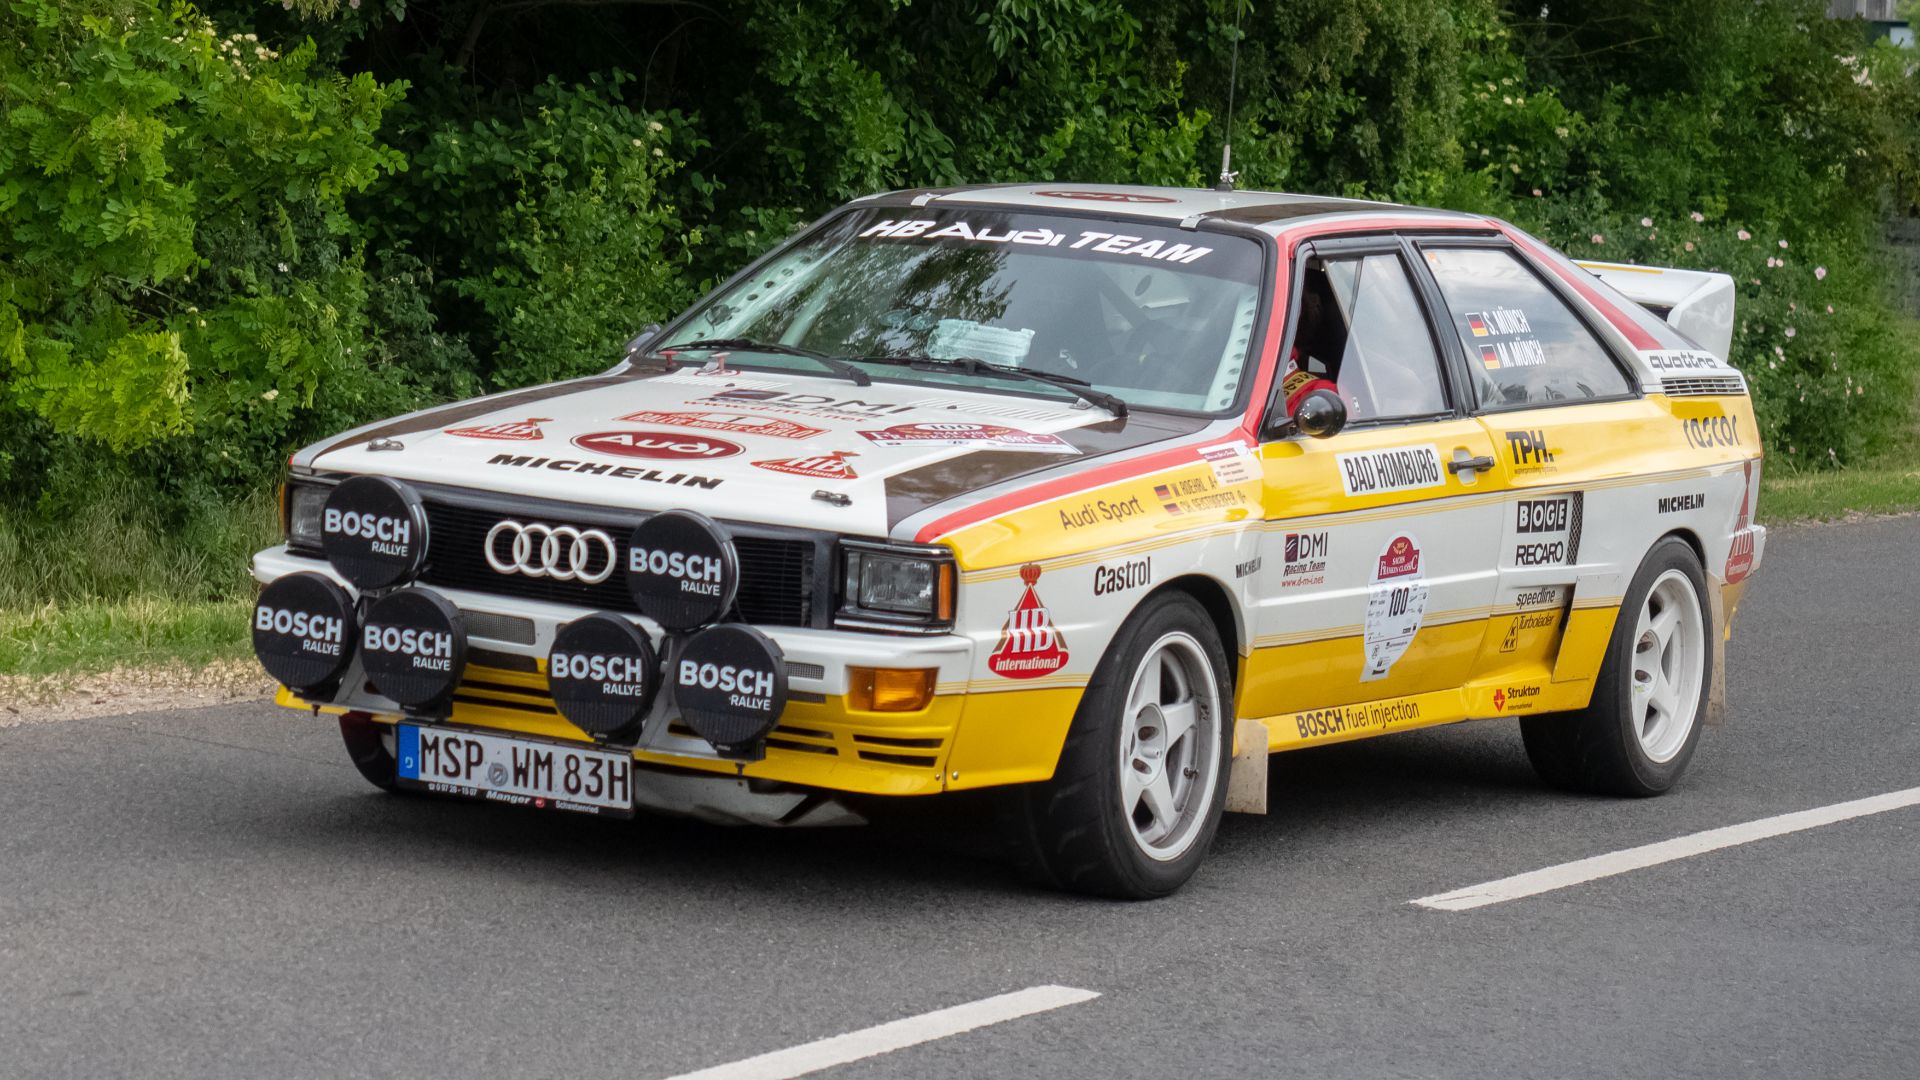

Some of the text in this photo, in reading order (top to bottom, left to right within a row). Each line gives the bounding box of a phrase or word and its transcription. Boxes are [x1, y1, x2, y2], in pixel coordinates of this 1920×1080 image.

[858, 219, 1213, 264] HB Audi TEAM
[1482, 305, 1531, 335] S. MÜNCH
[1496, 337, 1546, 368] M. MÜNCH
[1649, 352, 1718, 372] quattro
[778, 394, 917, 414] DMI
[584, 434, 728, 456] Audi
[1683, 414, 1741, 449] rascor
[487, 453, 725, 490] MICHELIN
[786, 455, 847, 473] HB
[1344, 448, 1439, 493] BAD HOMBURG
[1058, 495, 1144, 531] Audi Sport
[1518, 502, 1566, 528] BOGE
[1658, 493, 1705, 514] MICHELIN
[324, 507, 411, 544] BOSCH
[371, 540, 408, 557] RALLYE
[1299, 531, 1328, 559] DMI
[1515, 541, 1564, 566] RECARO
[629, 546, 722, 583] BOSCH
[1094, 556, 1151, 597] Castrol
[1235, 556, 1262, 579] MICHELIN
[1283, 560, 1326, 577] Racing Team
[680, 579, 721, 596] RALLYE
[1516, 588, 1556, 609] speedline
[1388, 587, 1410, 618] 100
[256, 605, 343, 643] BOSCH
[1007, 607, 1055, 654] HB
[1519, 613, 1554, 630] Turbolader
[302, 638, 340, 656] RALLYE
[363, 623, 453, 658] BOSCH
[412, 654, 451, 672] RALLYE
[551, 652, 643, 684] BOSCH
[994, 655, 1060, 671] international
[602, 681, 643, 697] RALLYE
[679, 659, 774, 698] BOSCH
[1508, 685, 1540, 699] Strukton
[730, 693, 771, 711] RALLYE
[1296, 698, 1420, 739] BOSCH fuel injection
[420, 733, 629, 802] MSP WM 83H
